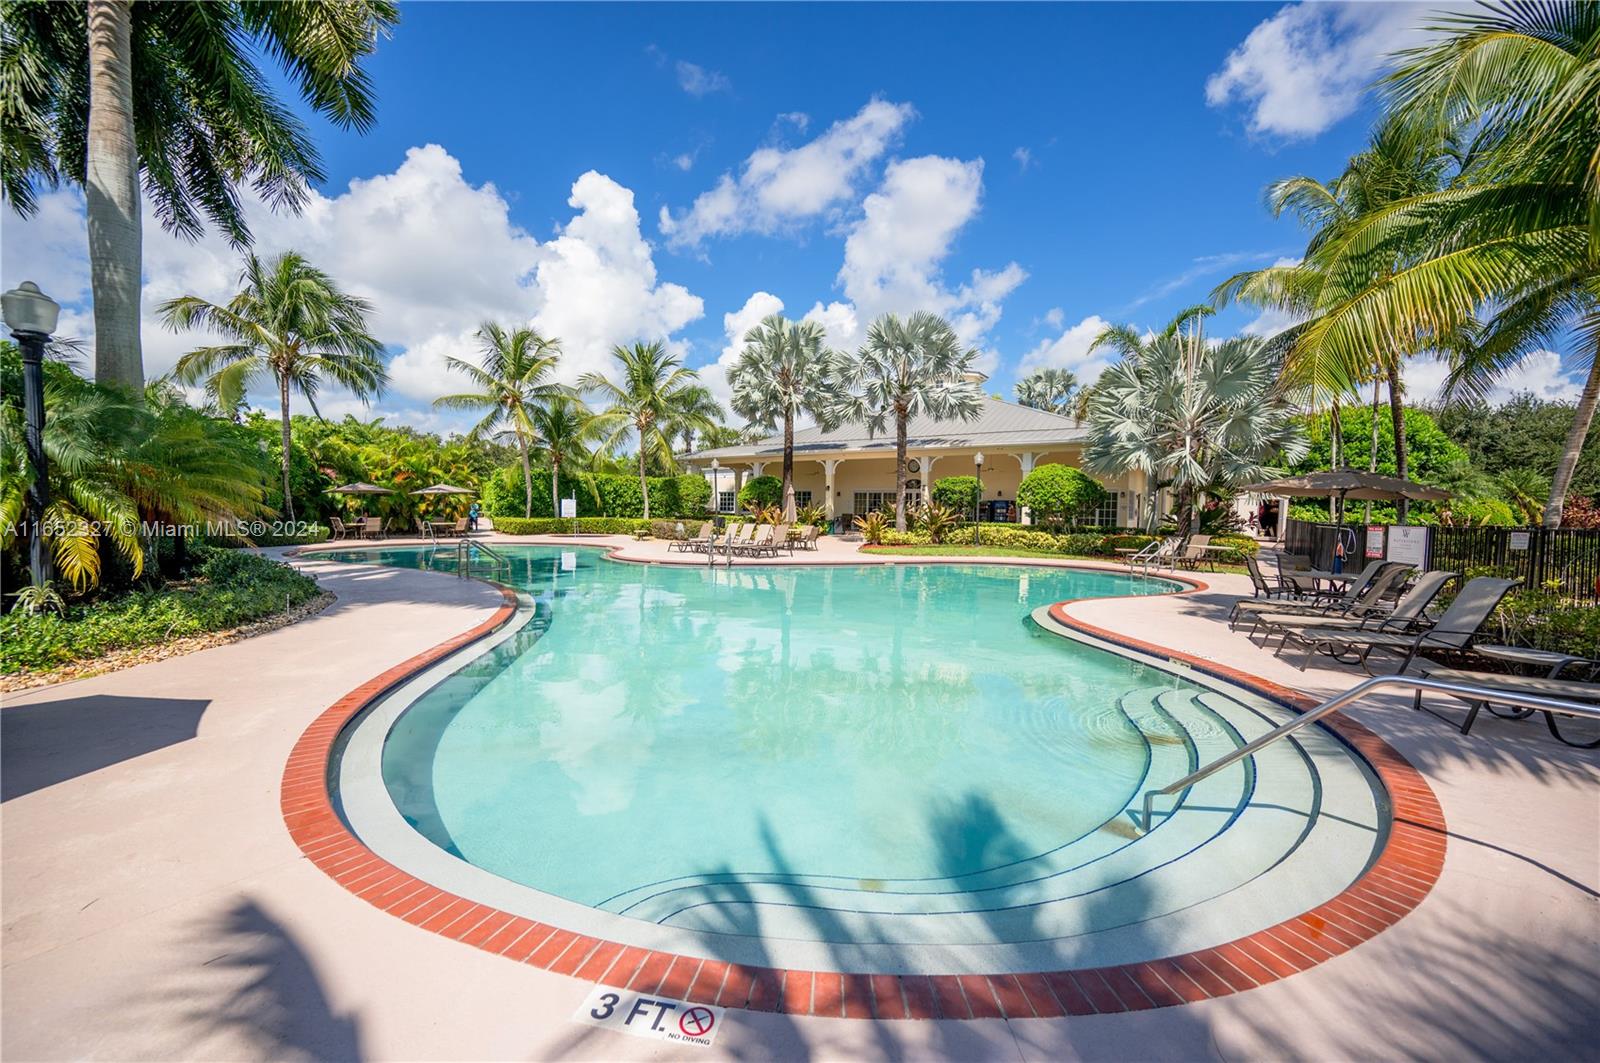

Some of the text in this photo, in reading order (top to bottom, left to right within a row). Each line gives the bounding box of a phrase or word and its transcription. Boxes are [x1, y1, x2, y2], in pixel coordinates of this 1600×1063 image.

[590, 993, 676, 1032] 3 FT.
[668, 1032, 710, 1045] NO DIVING
